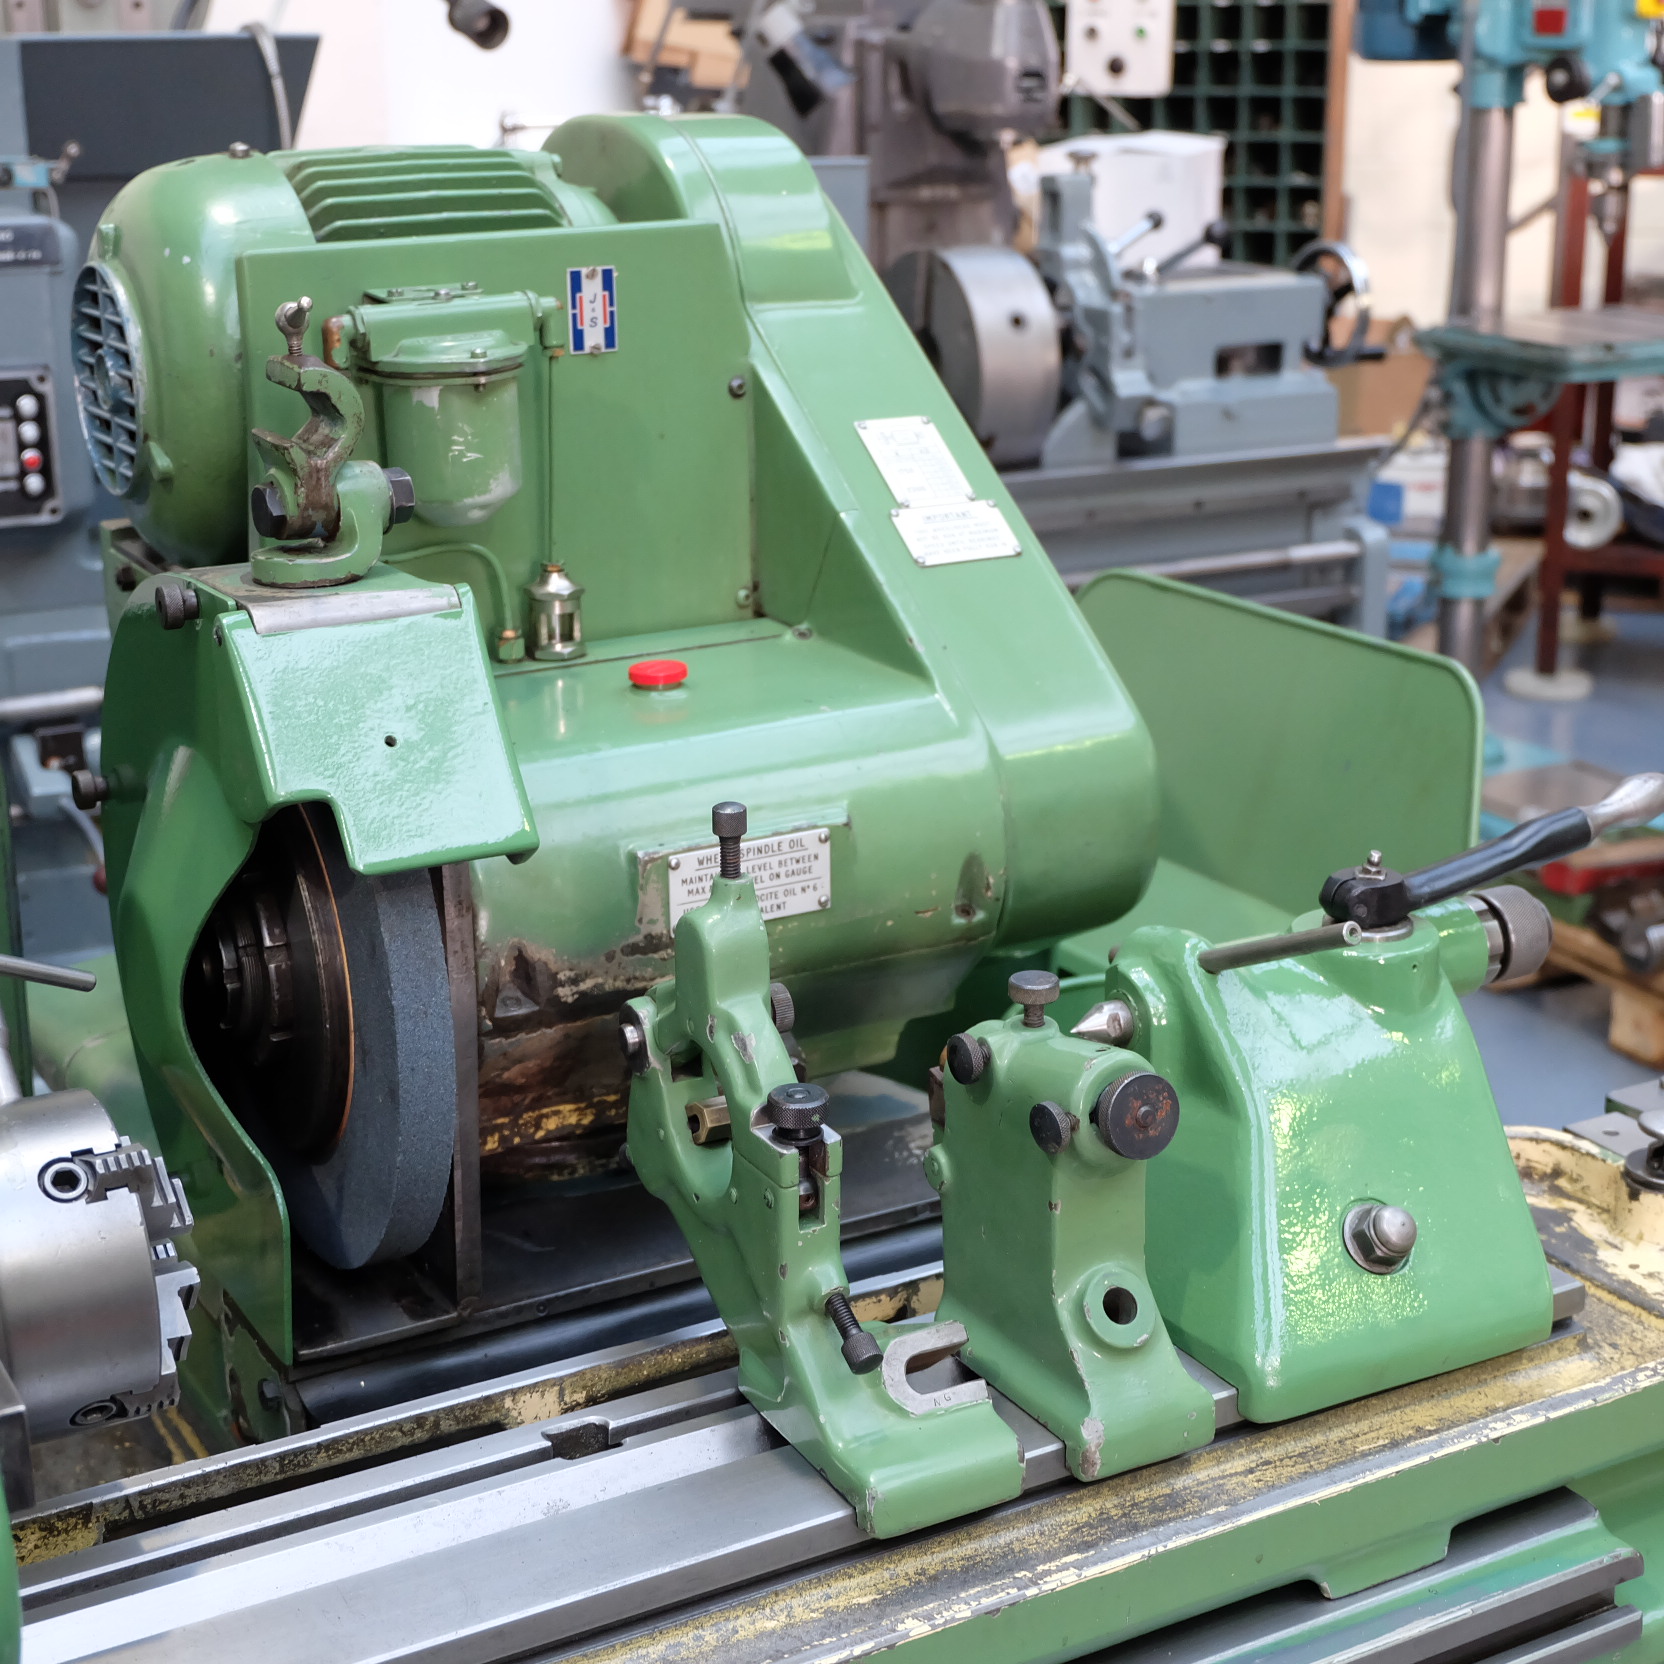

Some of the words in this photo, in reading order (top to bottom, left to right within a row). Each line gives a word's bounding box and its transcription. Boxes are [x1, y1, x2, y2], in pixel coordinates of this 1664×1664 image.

[697, 853, 720, 868] WHE
[740, 841, 783, 859] SPINDLE
[788, 838, 806, 850] OIL
[681, 873, 714, 887] MAINTA
[746, 862, 774, 875] LEVEL
[778, 853, 819, 868] BETWEEN
[687, 886, 706, 897] MAX
[768, 871, 781, 882] ON
[785, 865, 813, 878] GAUGE
[783, 887, 797, 898] OIL
[812, 882, 818, 892] 6
